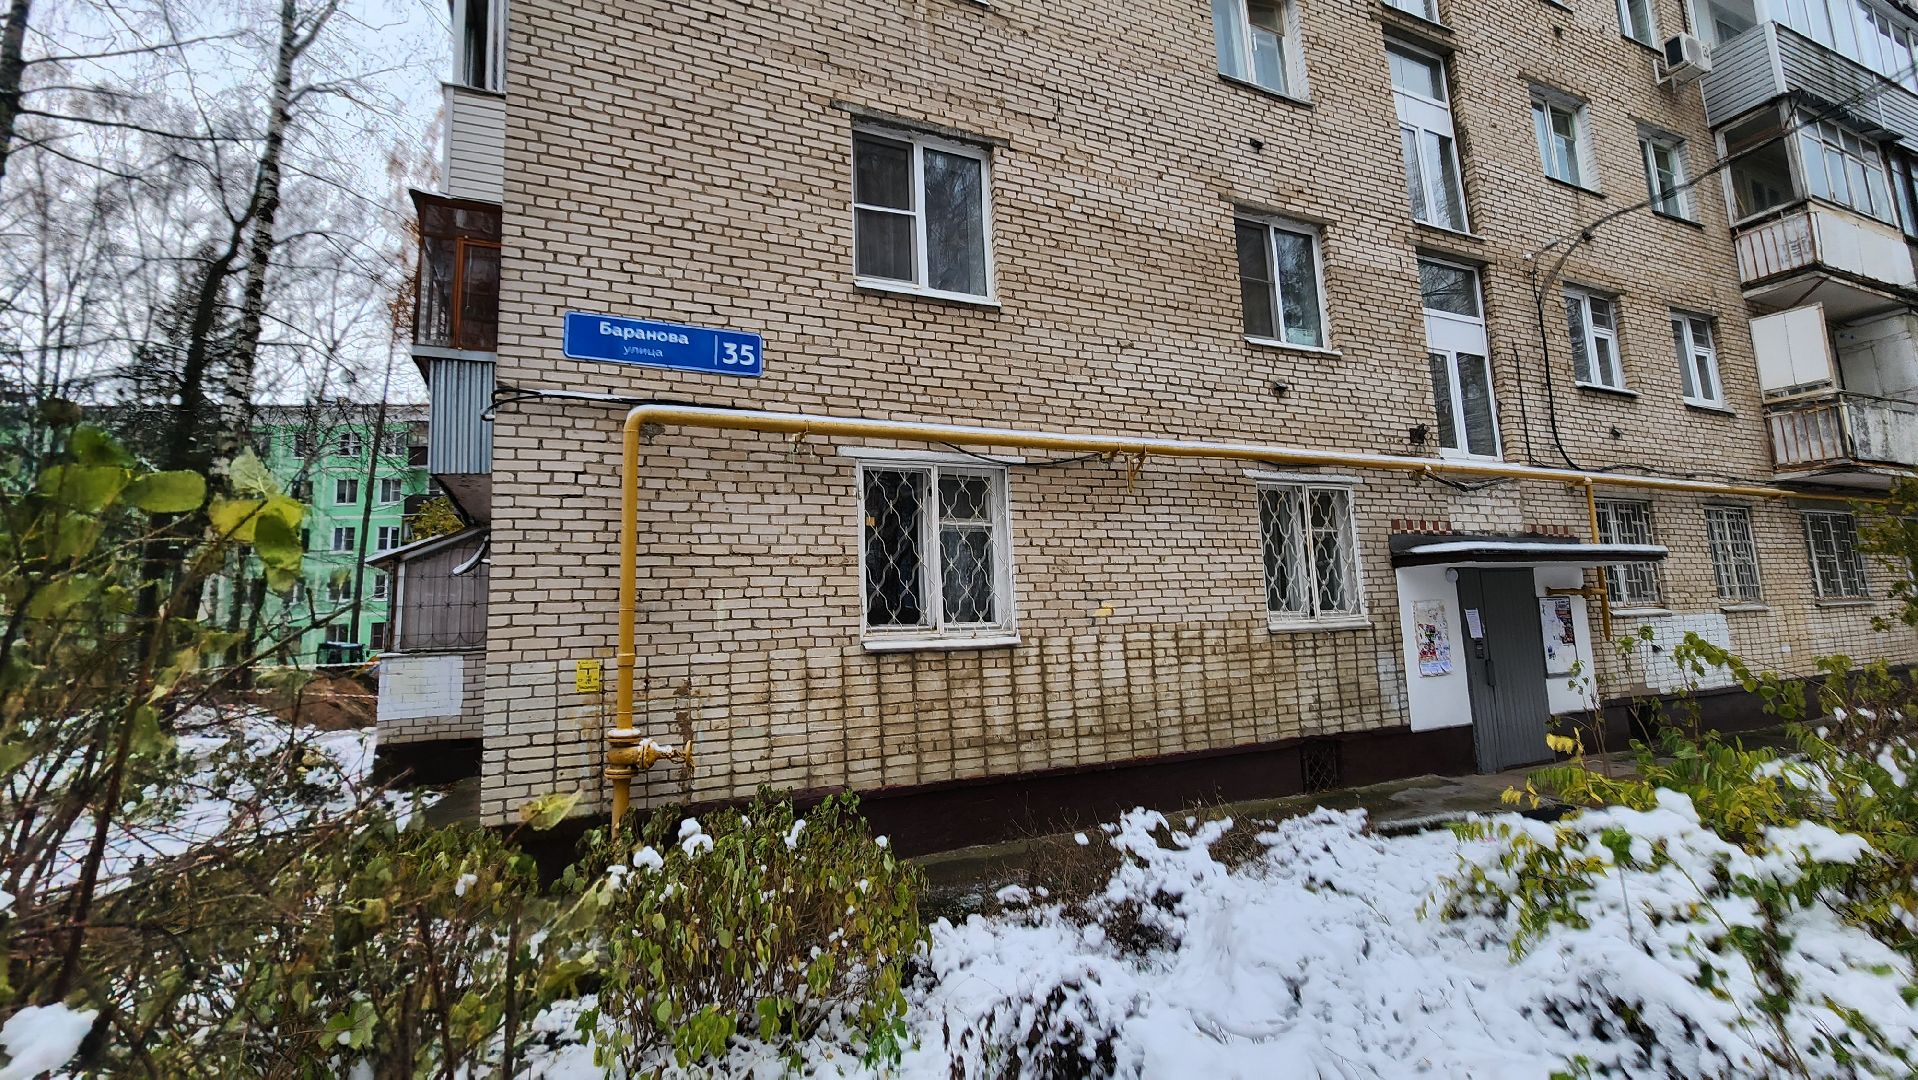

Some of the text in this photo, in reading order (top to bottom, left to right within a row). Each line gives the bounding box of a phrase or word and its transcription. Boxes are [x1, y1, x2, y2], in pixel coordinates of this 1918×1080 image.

[599, 321, 689, 345] Баранова
[623, 345, 664, 358] улица
[722, 341, 755, 366] 35
